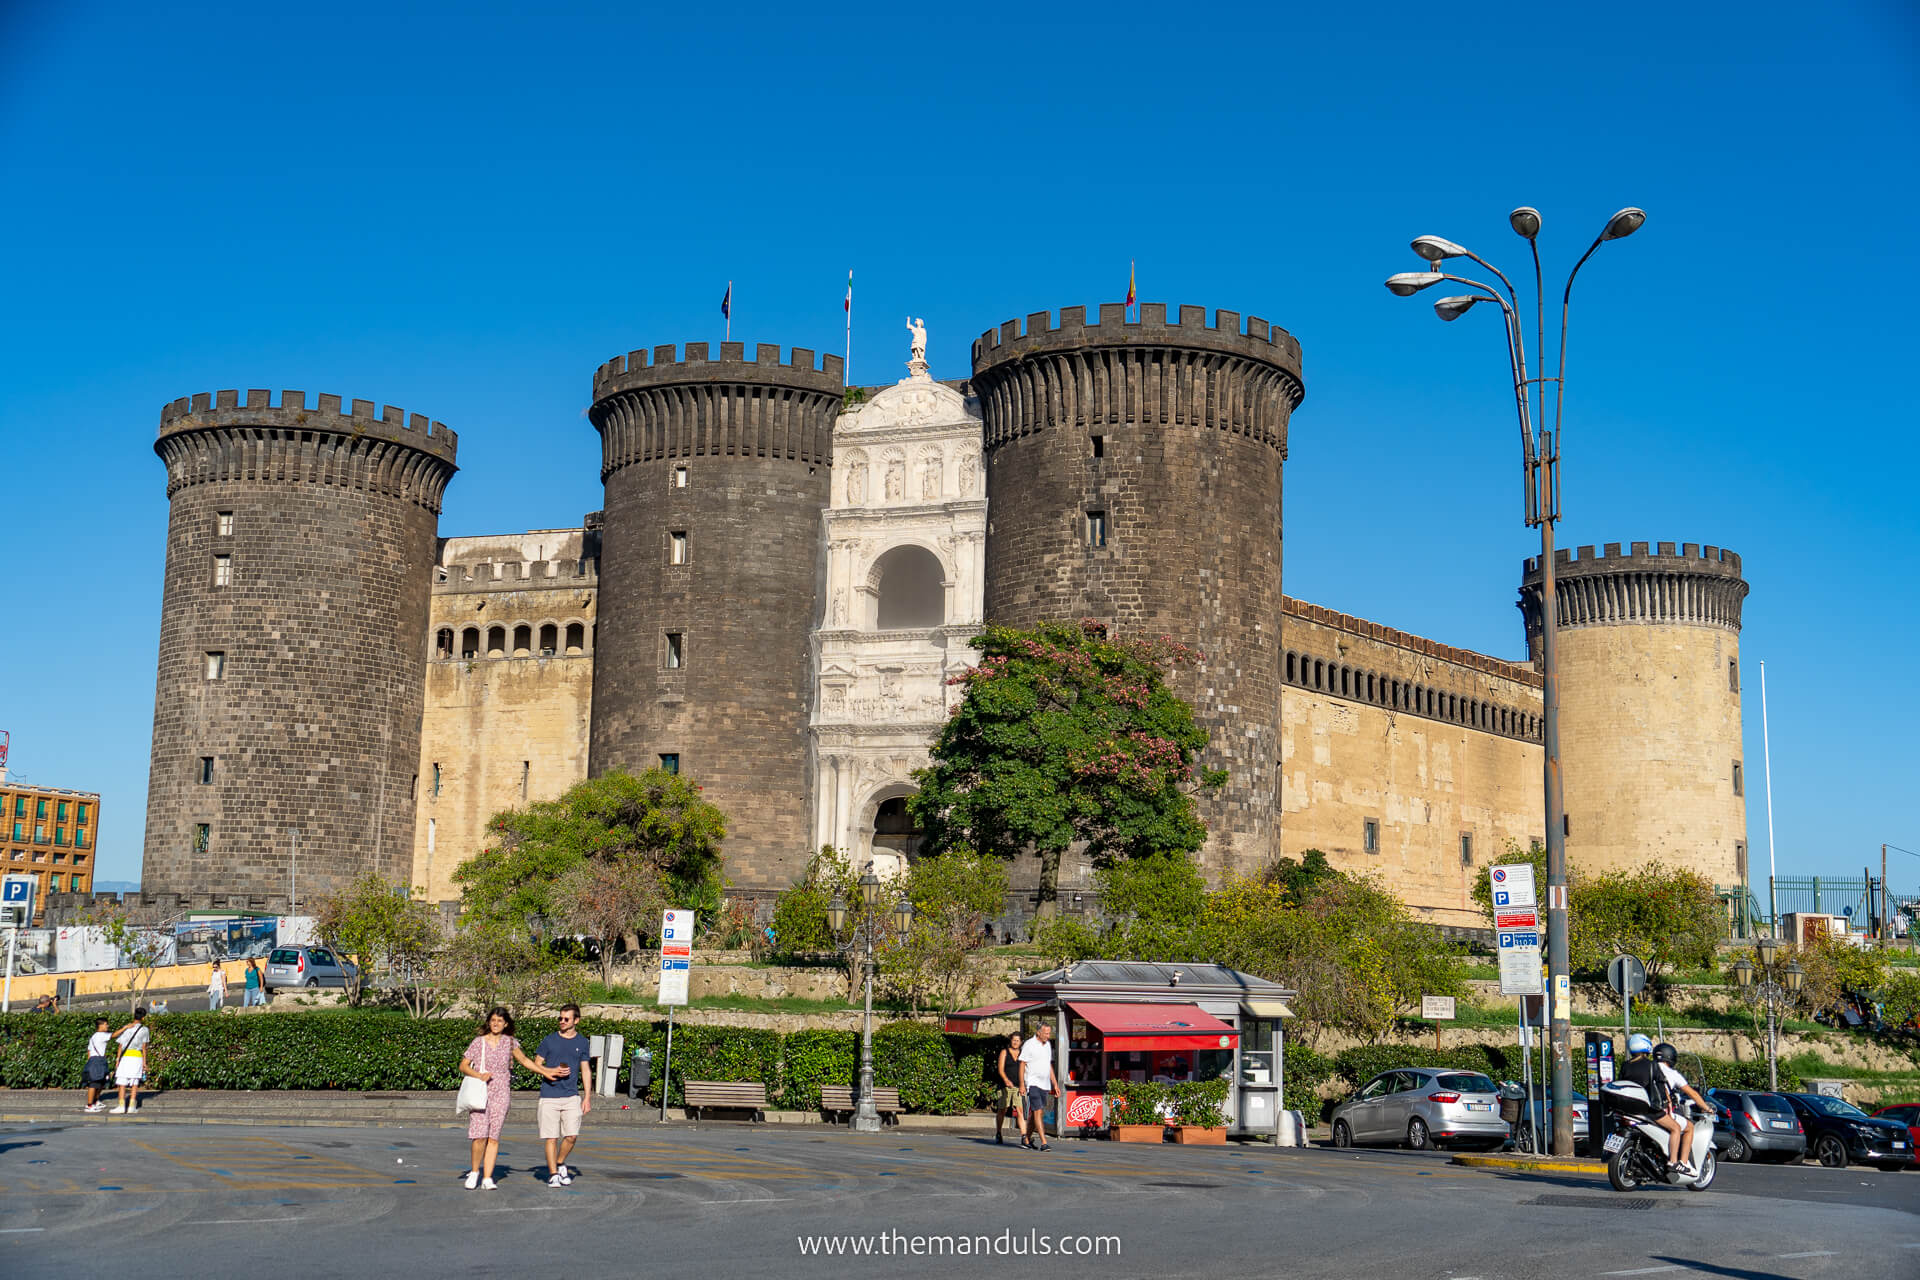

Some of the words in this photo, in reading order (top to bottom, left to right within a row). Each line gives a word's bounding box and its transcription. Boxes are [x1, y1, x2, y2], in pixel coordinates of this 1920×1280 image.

[10, 883, 22, 899] P
[1498, 893, 1506, 904] P
[665, 929, 673, 938] P
[1502, 935, 1511, 946] P
[664, 960, 671, 969] P
[1588, 1045, 1594, 1057] P
[1601, 1042, 1608, 1056] P
[1070, 1099, 1099, 1118] OFFICIAL
